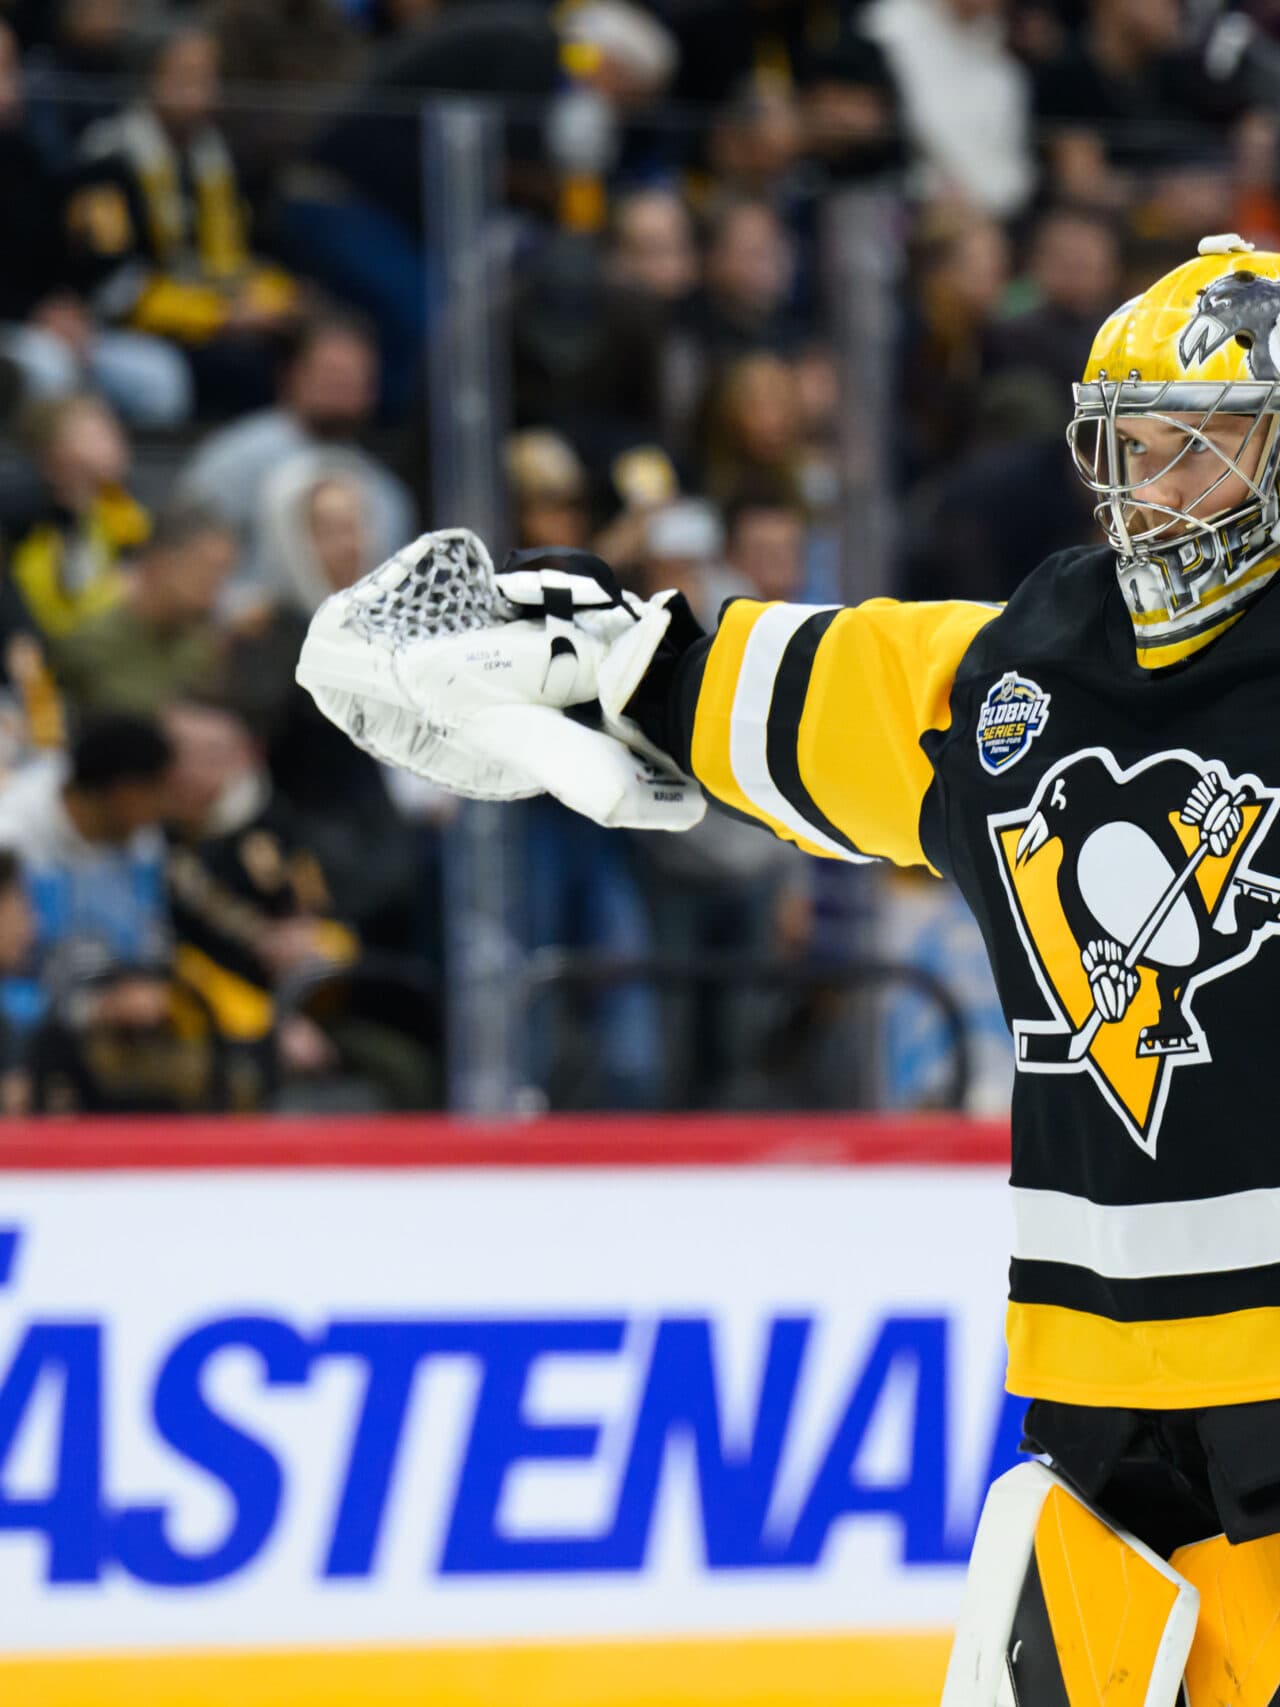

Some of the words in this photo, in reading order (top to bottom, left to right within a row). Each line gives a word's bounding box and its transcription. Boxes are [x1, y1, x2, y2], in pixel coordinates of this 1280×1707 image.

[982, 700, 1042, 727] GLOBAL
[983, 723, 1026, 741] SERIES
[0, 1228, 1034, 1588] ASTENA
